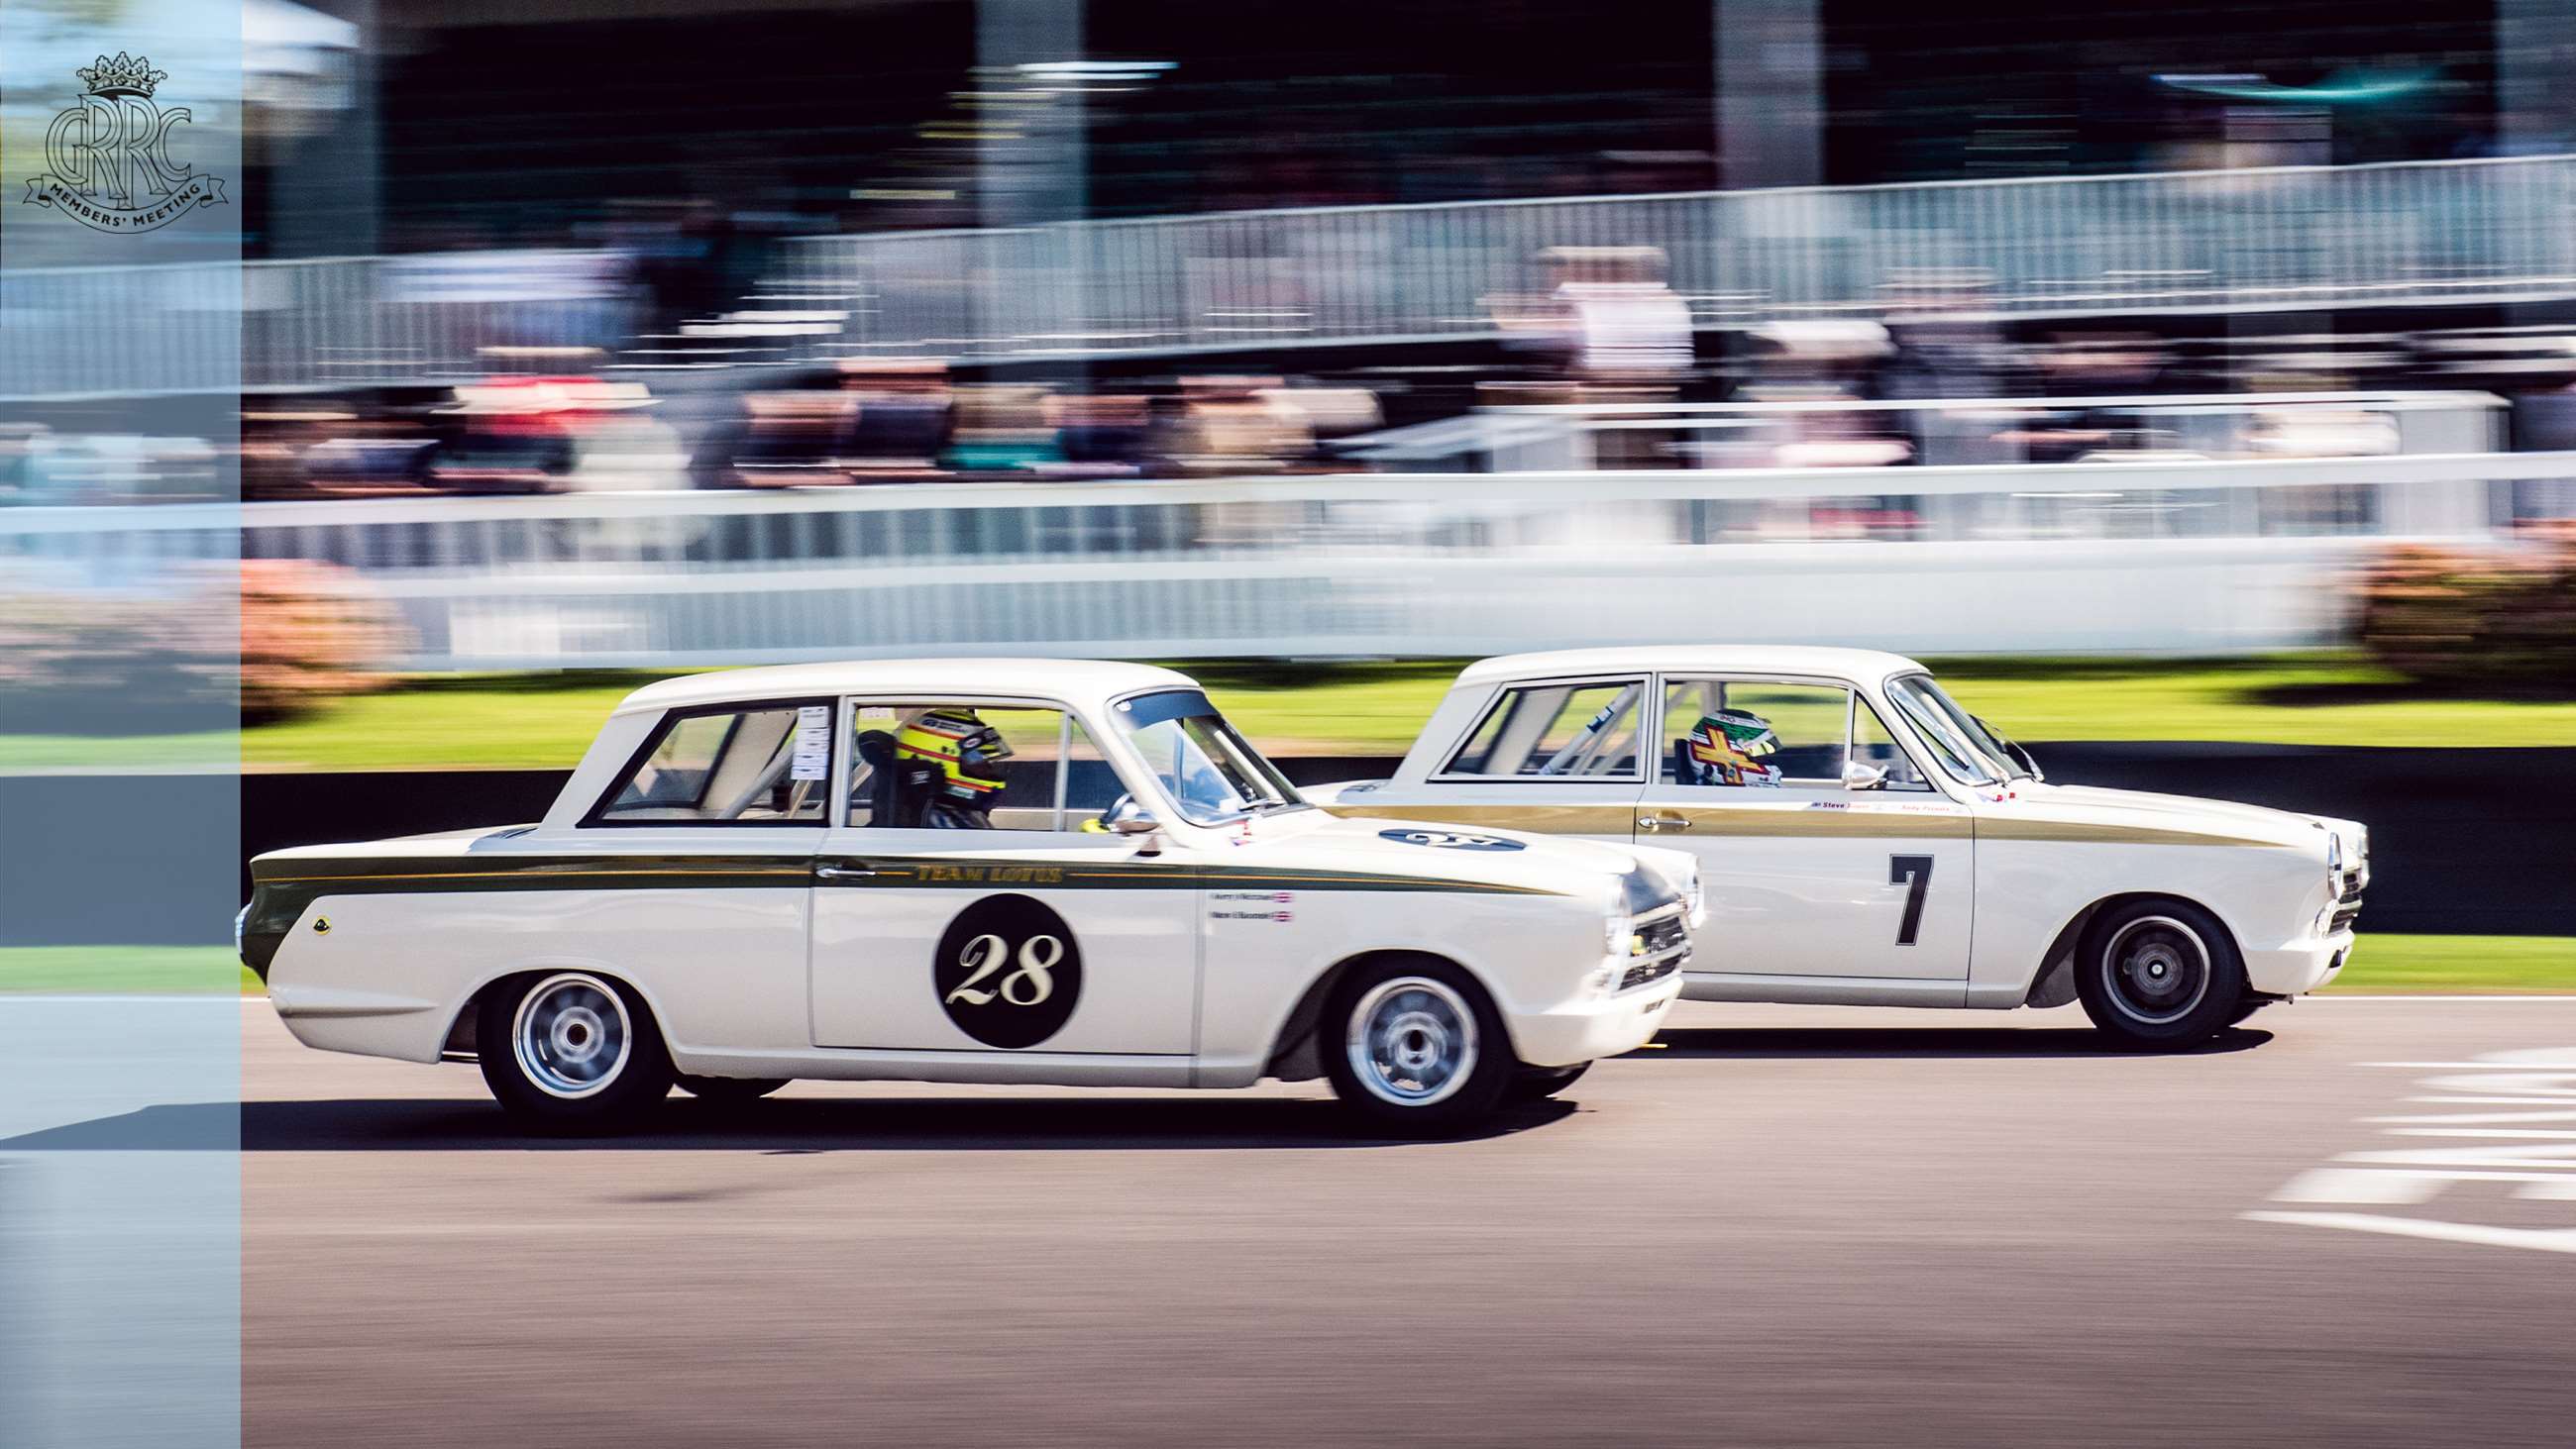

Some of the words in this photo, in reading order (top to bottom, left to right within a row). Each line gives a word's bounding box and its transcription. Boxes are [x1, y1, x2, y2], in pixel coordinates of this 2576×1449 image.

[918, 864, 984, 880] TEAM
[1888, 853, 1935, 947] 7
[944, 934, 1064, 1006] 28
